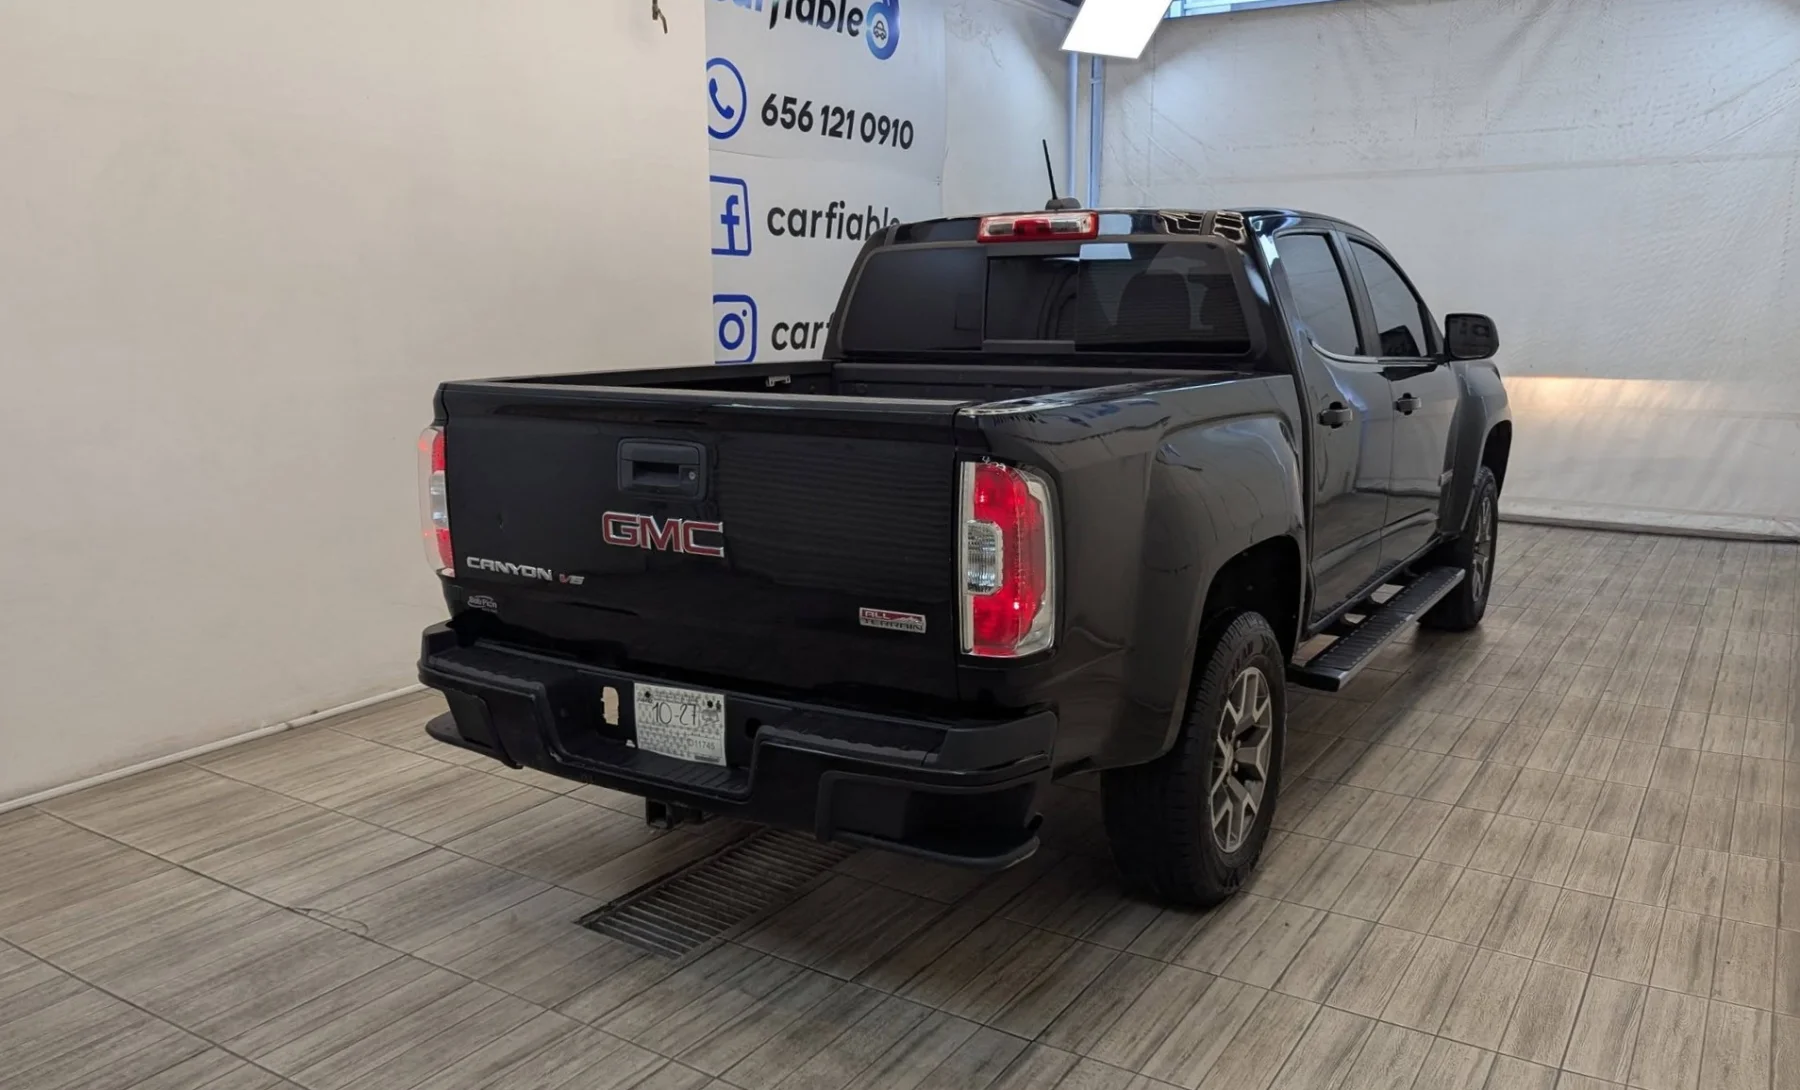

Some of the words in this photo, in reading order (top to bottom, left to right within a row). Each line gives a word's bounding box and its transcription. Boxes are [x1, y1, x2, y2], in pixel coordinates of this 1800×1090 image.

[761, 93, 814, 133] 656
[820, 105, 856, 140] 121
[860, 112, 914, 150] 0910
[767, 200, 900, 241] carfiabl
[771, 312, 834, 351] car
[602, 511, 724, 558] GMC
[466, 556, 553, 581] CANYON
[559, 573, 585, 585] V6
[864, 611, 890, 620] ALL
[864, 618, 923, 631] TERRAIN
